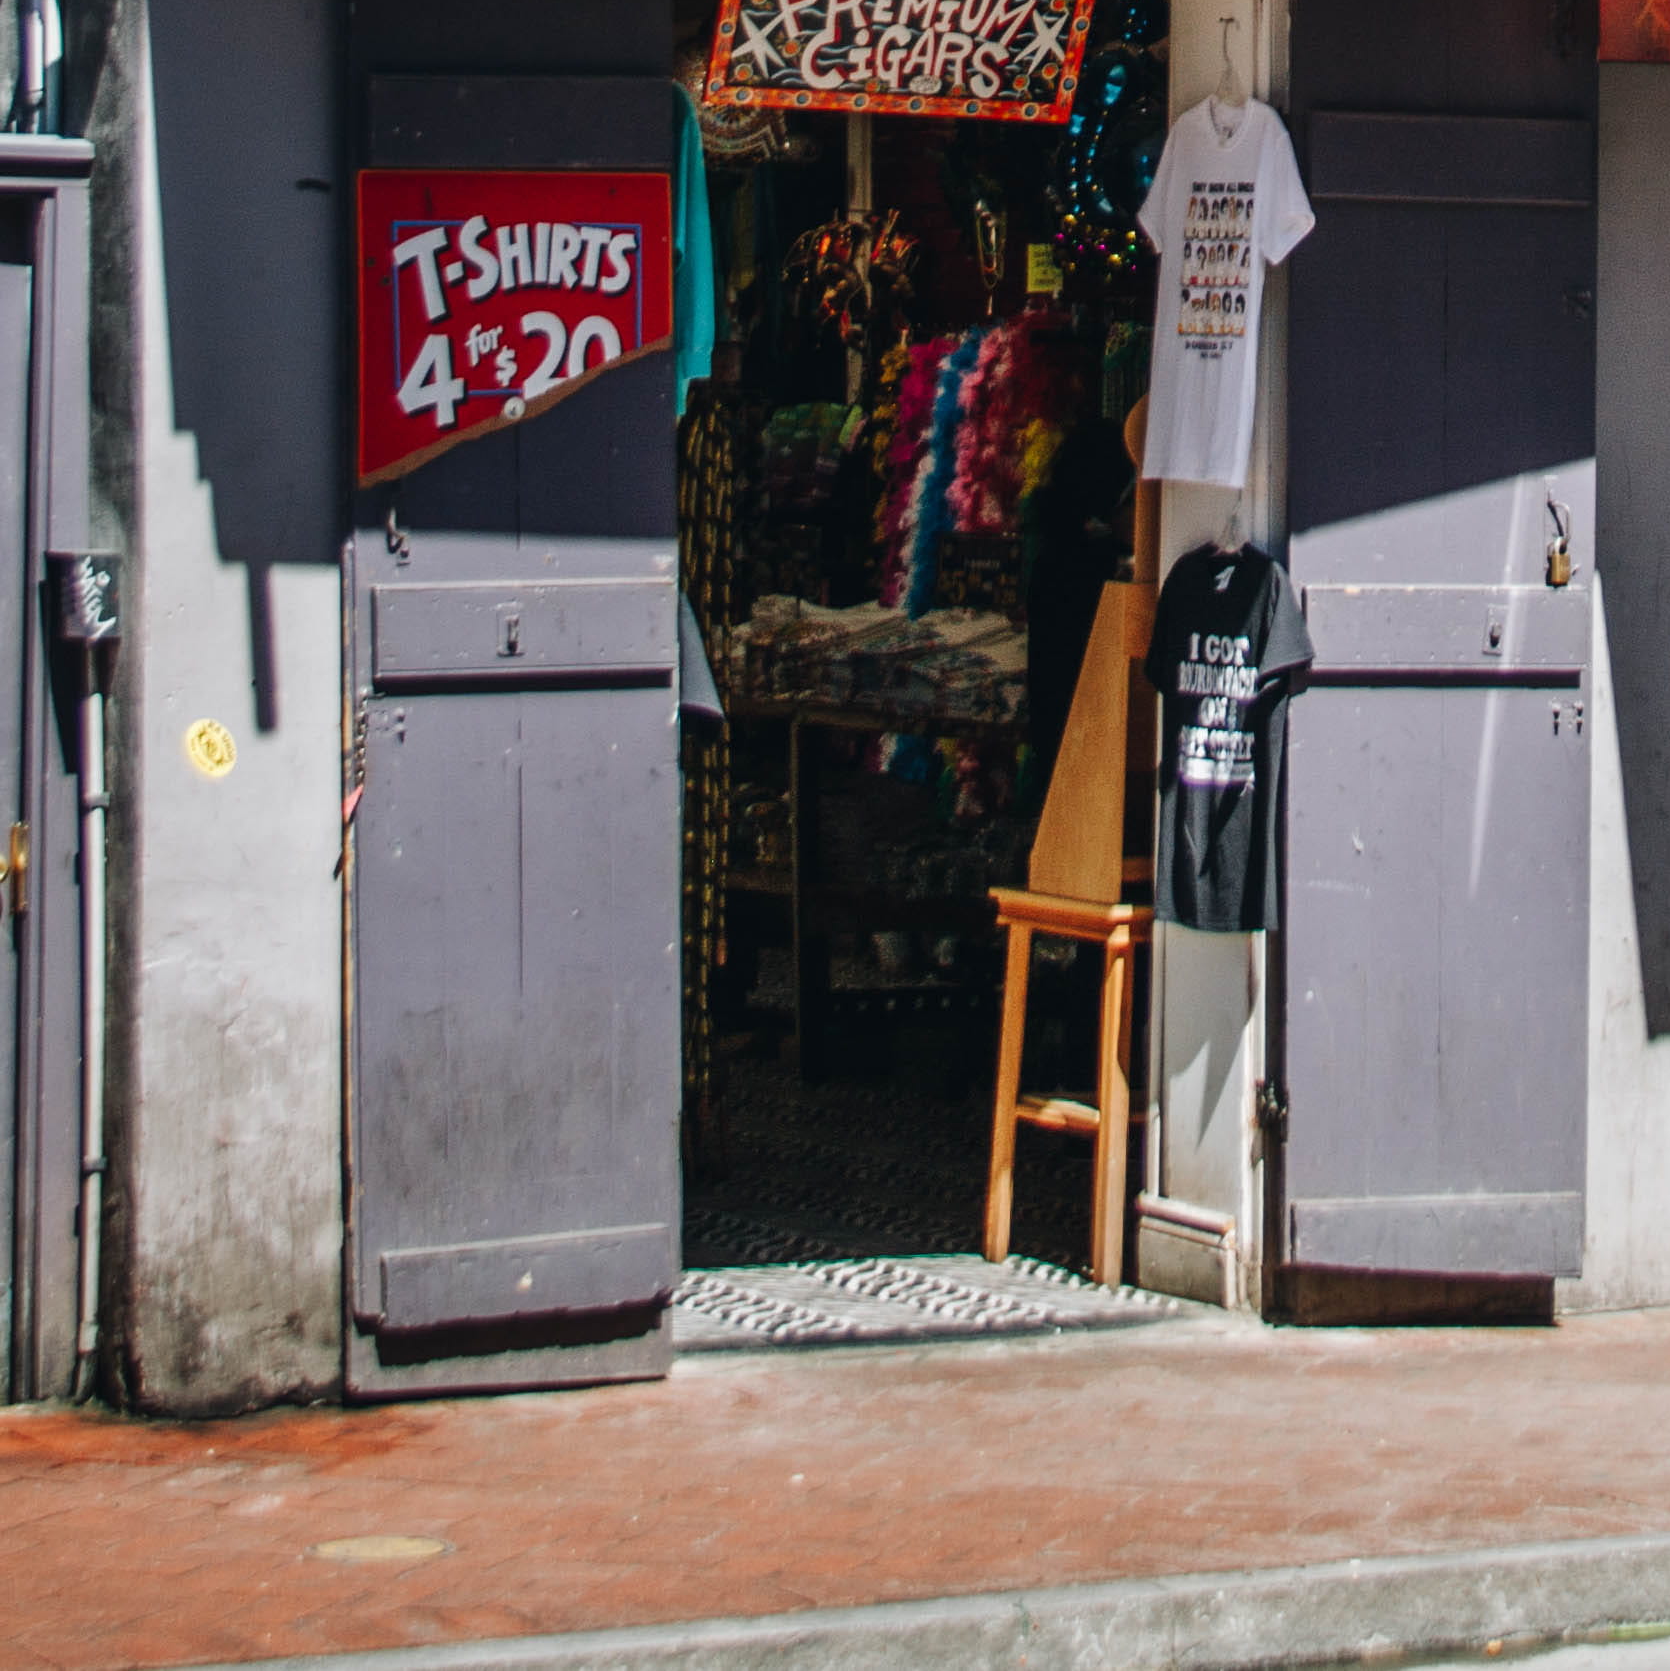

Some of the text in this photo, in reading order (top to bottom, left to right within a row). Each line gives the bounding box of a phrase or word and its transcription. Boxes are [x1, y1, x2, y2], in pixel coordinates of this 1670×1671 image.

[393, 215, 637, 322] T-SHIRTS
[397, 333, 465, 428] 4
[464, 323, 503, 366] for
[1205, 634, 1249, 667] GOT
